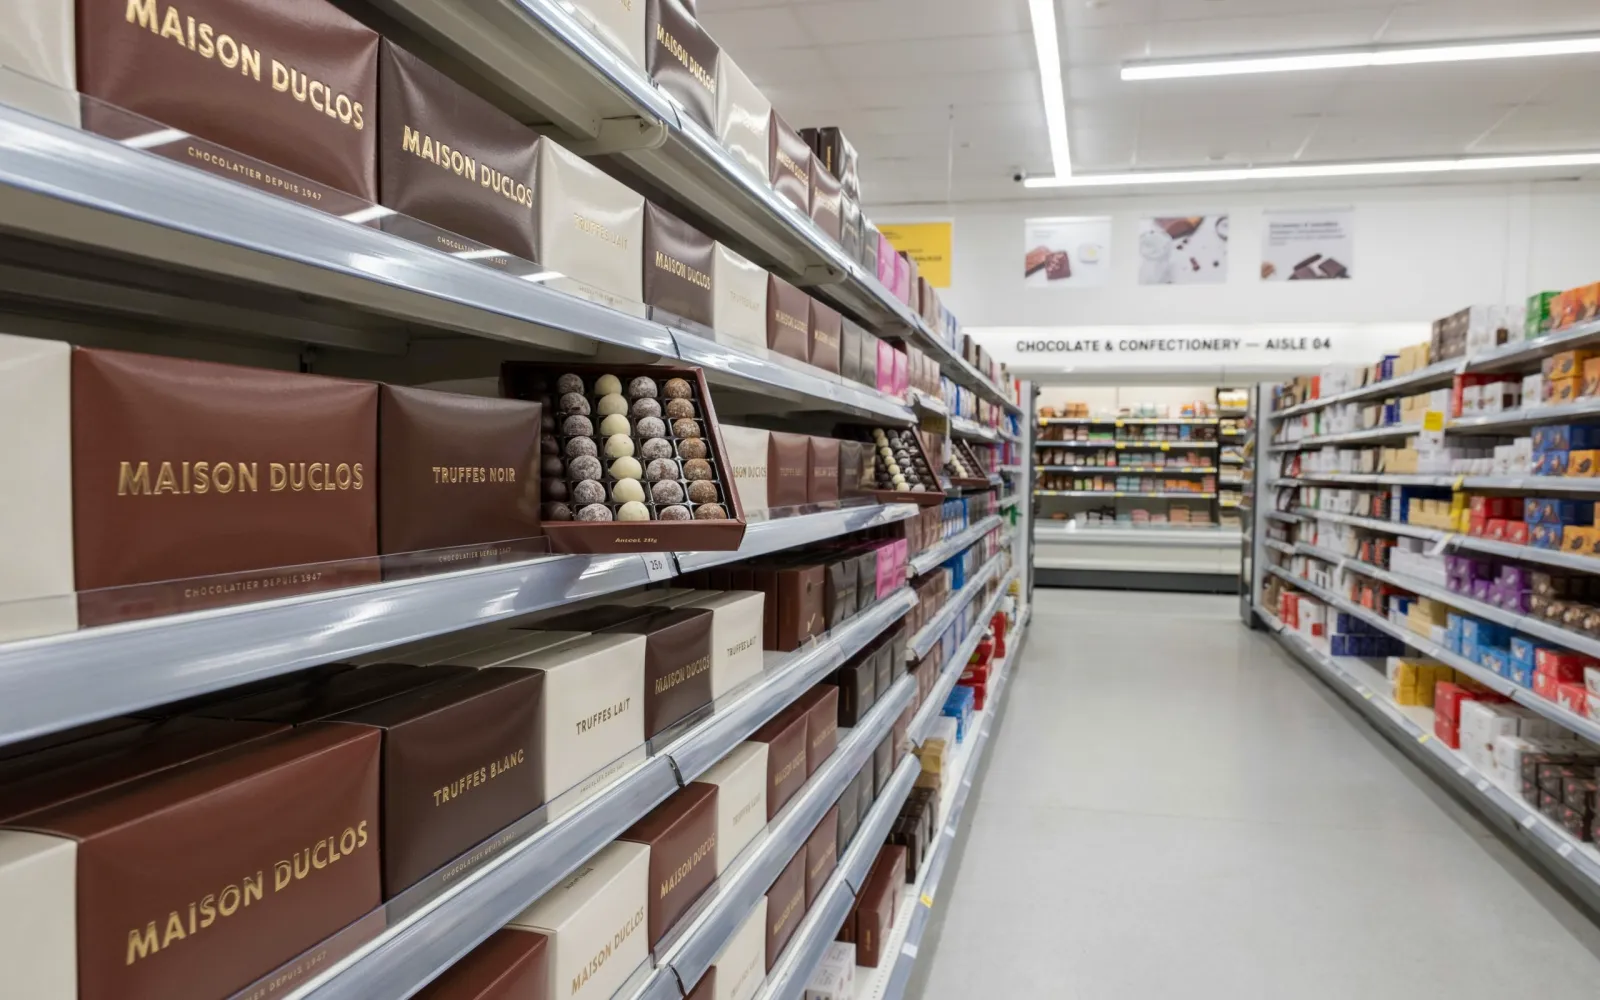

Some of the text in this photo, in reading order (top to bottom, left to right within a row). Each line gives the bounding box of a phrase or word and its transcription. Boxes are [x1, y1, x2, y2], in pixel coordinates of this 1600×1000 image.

[125, 0, 364, 131] MAISON DUCLOS
[656, 23, 688, 68] MAISON
[188, 146, 322, 201] CHOCOLATIER DEPUIS 1947
[402, 125, 533, 209] MAISON DUCLOS
[655, 250, 686, 279] MAISON
[1016, 340, 1100, 352] CHOCOLATE
[1104, 341, 1114, 352] &
[1119, 338, 1241, 352] CONFECTIONERY
[1265, 338, 1307, 350] AISLE
[1312, 337, 1332, 350] 04
[117, 460, 364, 496] MAISON DUCLOS
[432, 466, 516, 484] TRUFFES NOIR
[184, 572, 323, 599] CHOCOLATIER DEPUIS 1947
[655, 667, 685, 694] MAISON
[576, 697, 631, 735] TRUFFES LAIT
[433, 749, 524, 807] TRUFFES BLANC
[126, 819, 368, 966] MAISON DUCLOS
[660, 856, 692, 899] MAISON
[571, 905, 644, 996] MAISON DUCLOS
